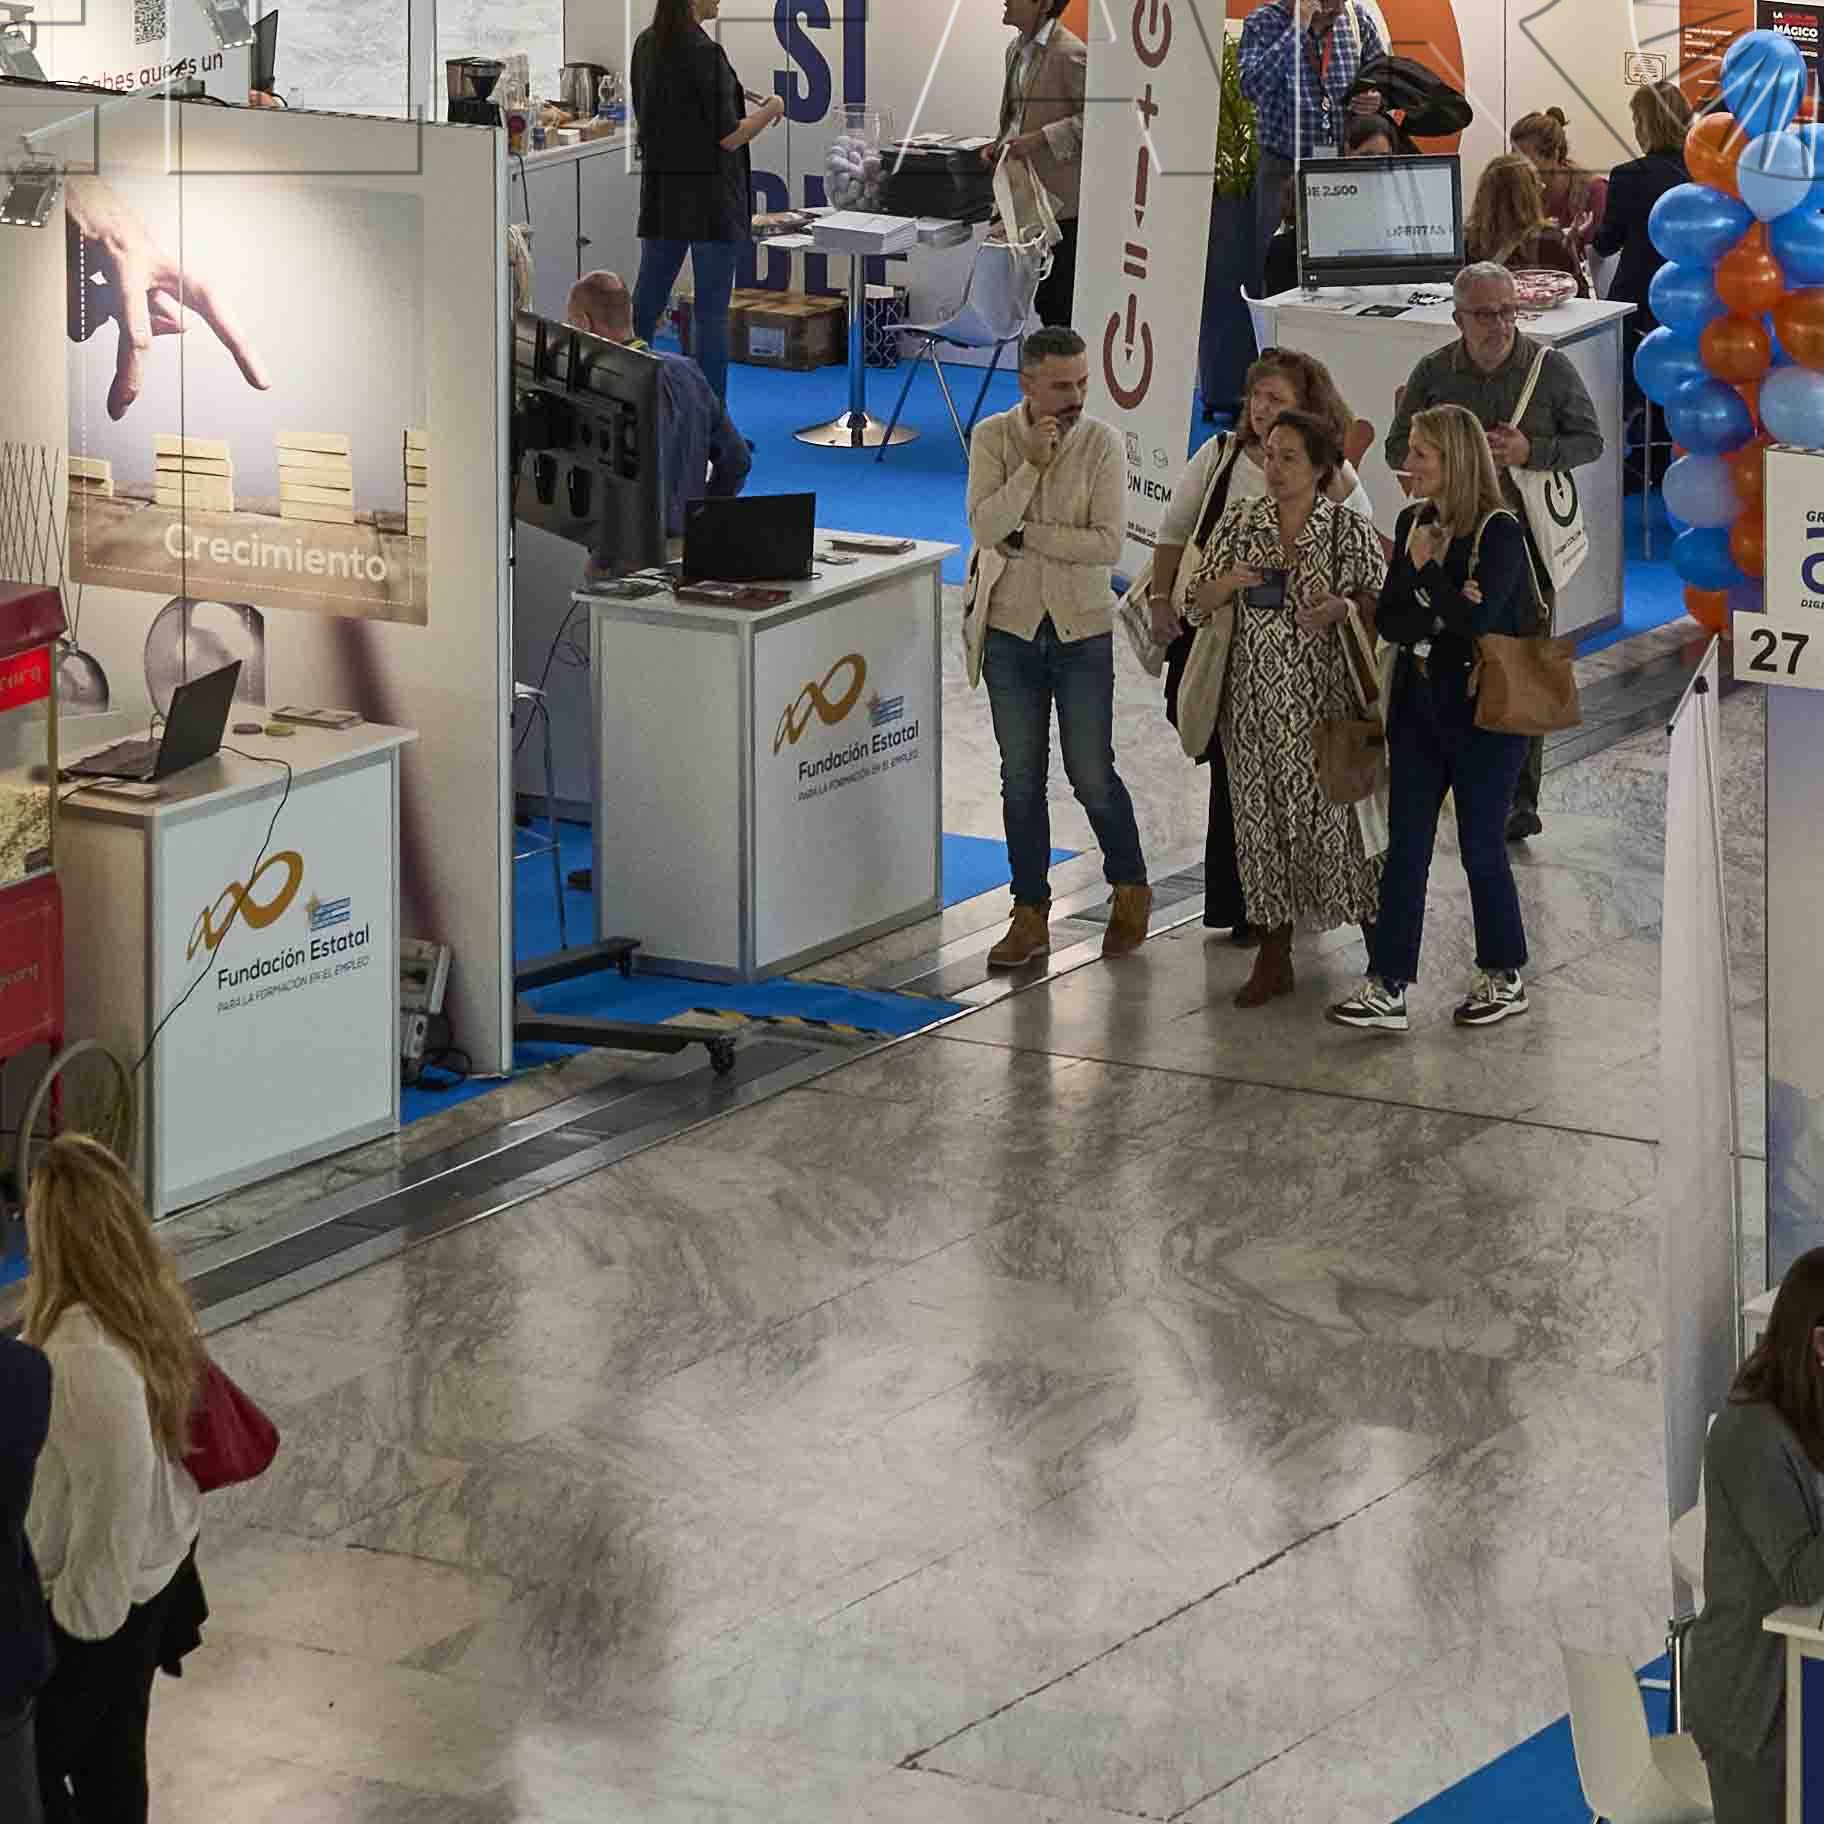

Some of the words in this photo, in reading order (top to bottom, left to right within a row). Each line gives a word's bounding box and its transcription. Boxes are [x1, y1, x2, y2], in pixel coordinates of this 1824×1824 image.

[1773, 23, 1819, 39] MÁGICO
[201, 51, 224, 72] un
[1143, 478, 1173, 504] IECM
[162, 522, 387, 582] Crecimiento
[1748, 626, 1810, 677] 27
[798, 739, 870, 782] Fundación
[871, 719, 919, 755] Estatal
[217, 947, 306, 991] Fundación
[309, 920, 370, 962] Estatal
